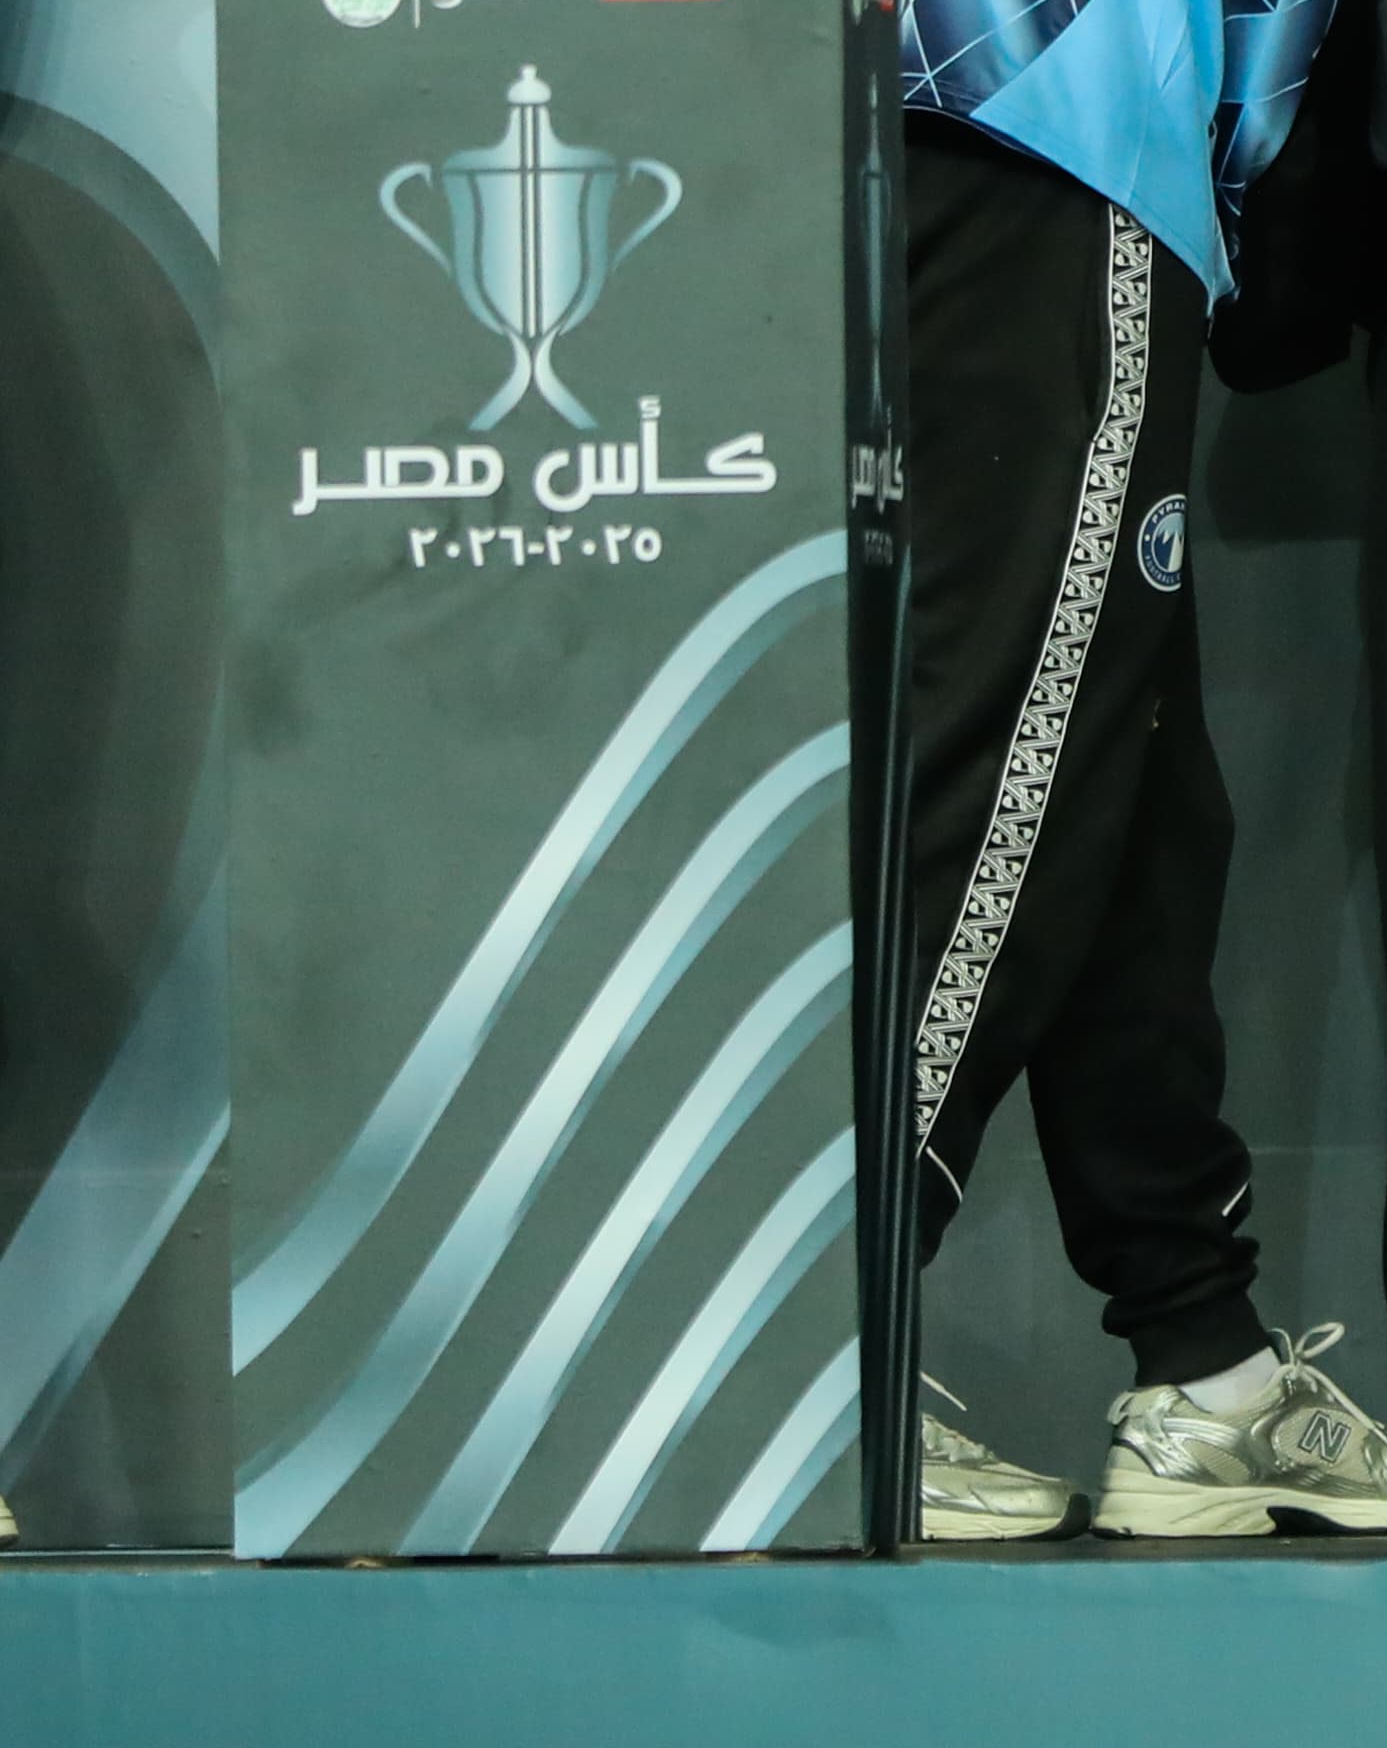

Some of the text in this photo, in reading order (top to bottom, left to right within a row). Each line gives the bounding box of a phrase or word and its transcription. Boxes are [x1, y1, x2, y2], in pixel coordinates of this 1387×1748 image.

[292, 395, 776, 517] كأس مصر
[1297, 1410, 1352, 1463] N
